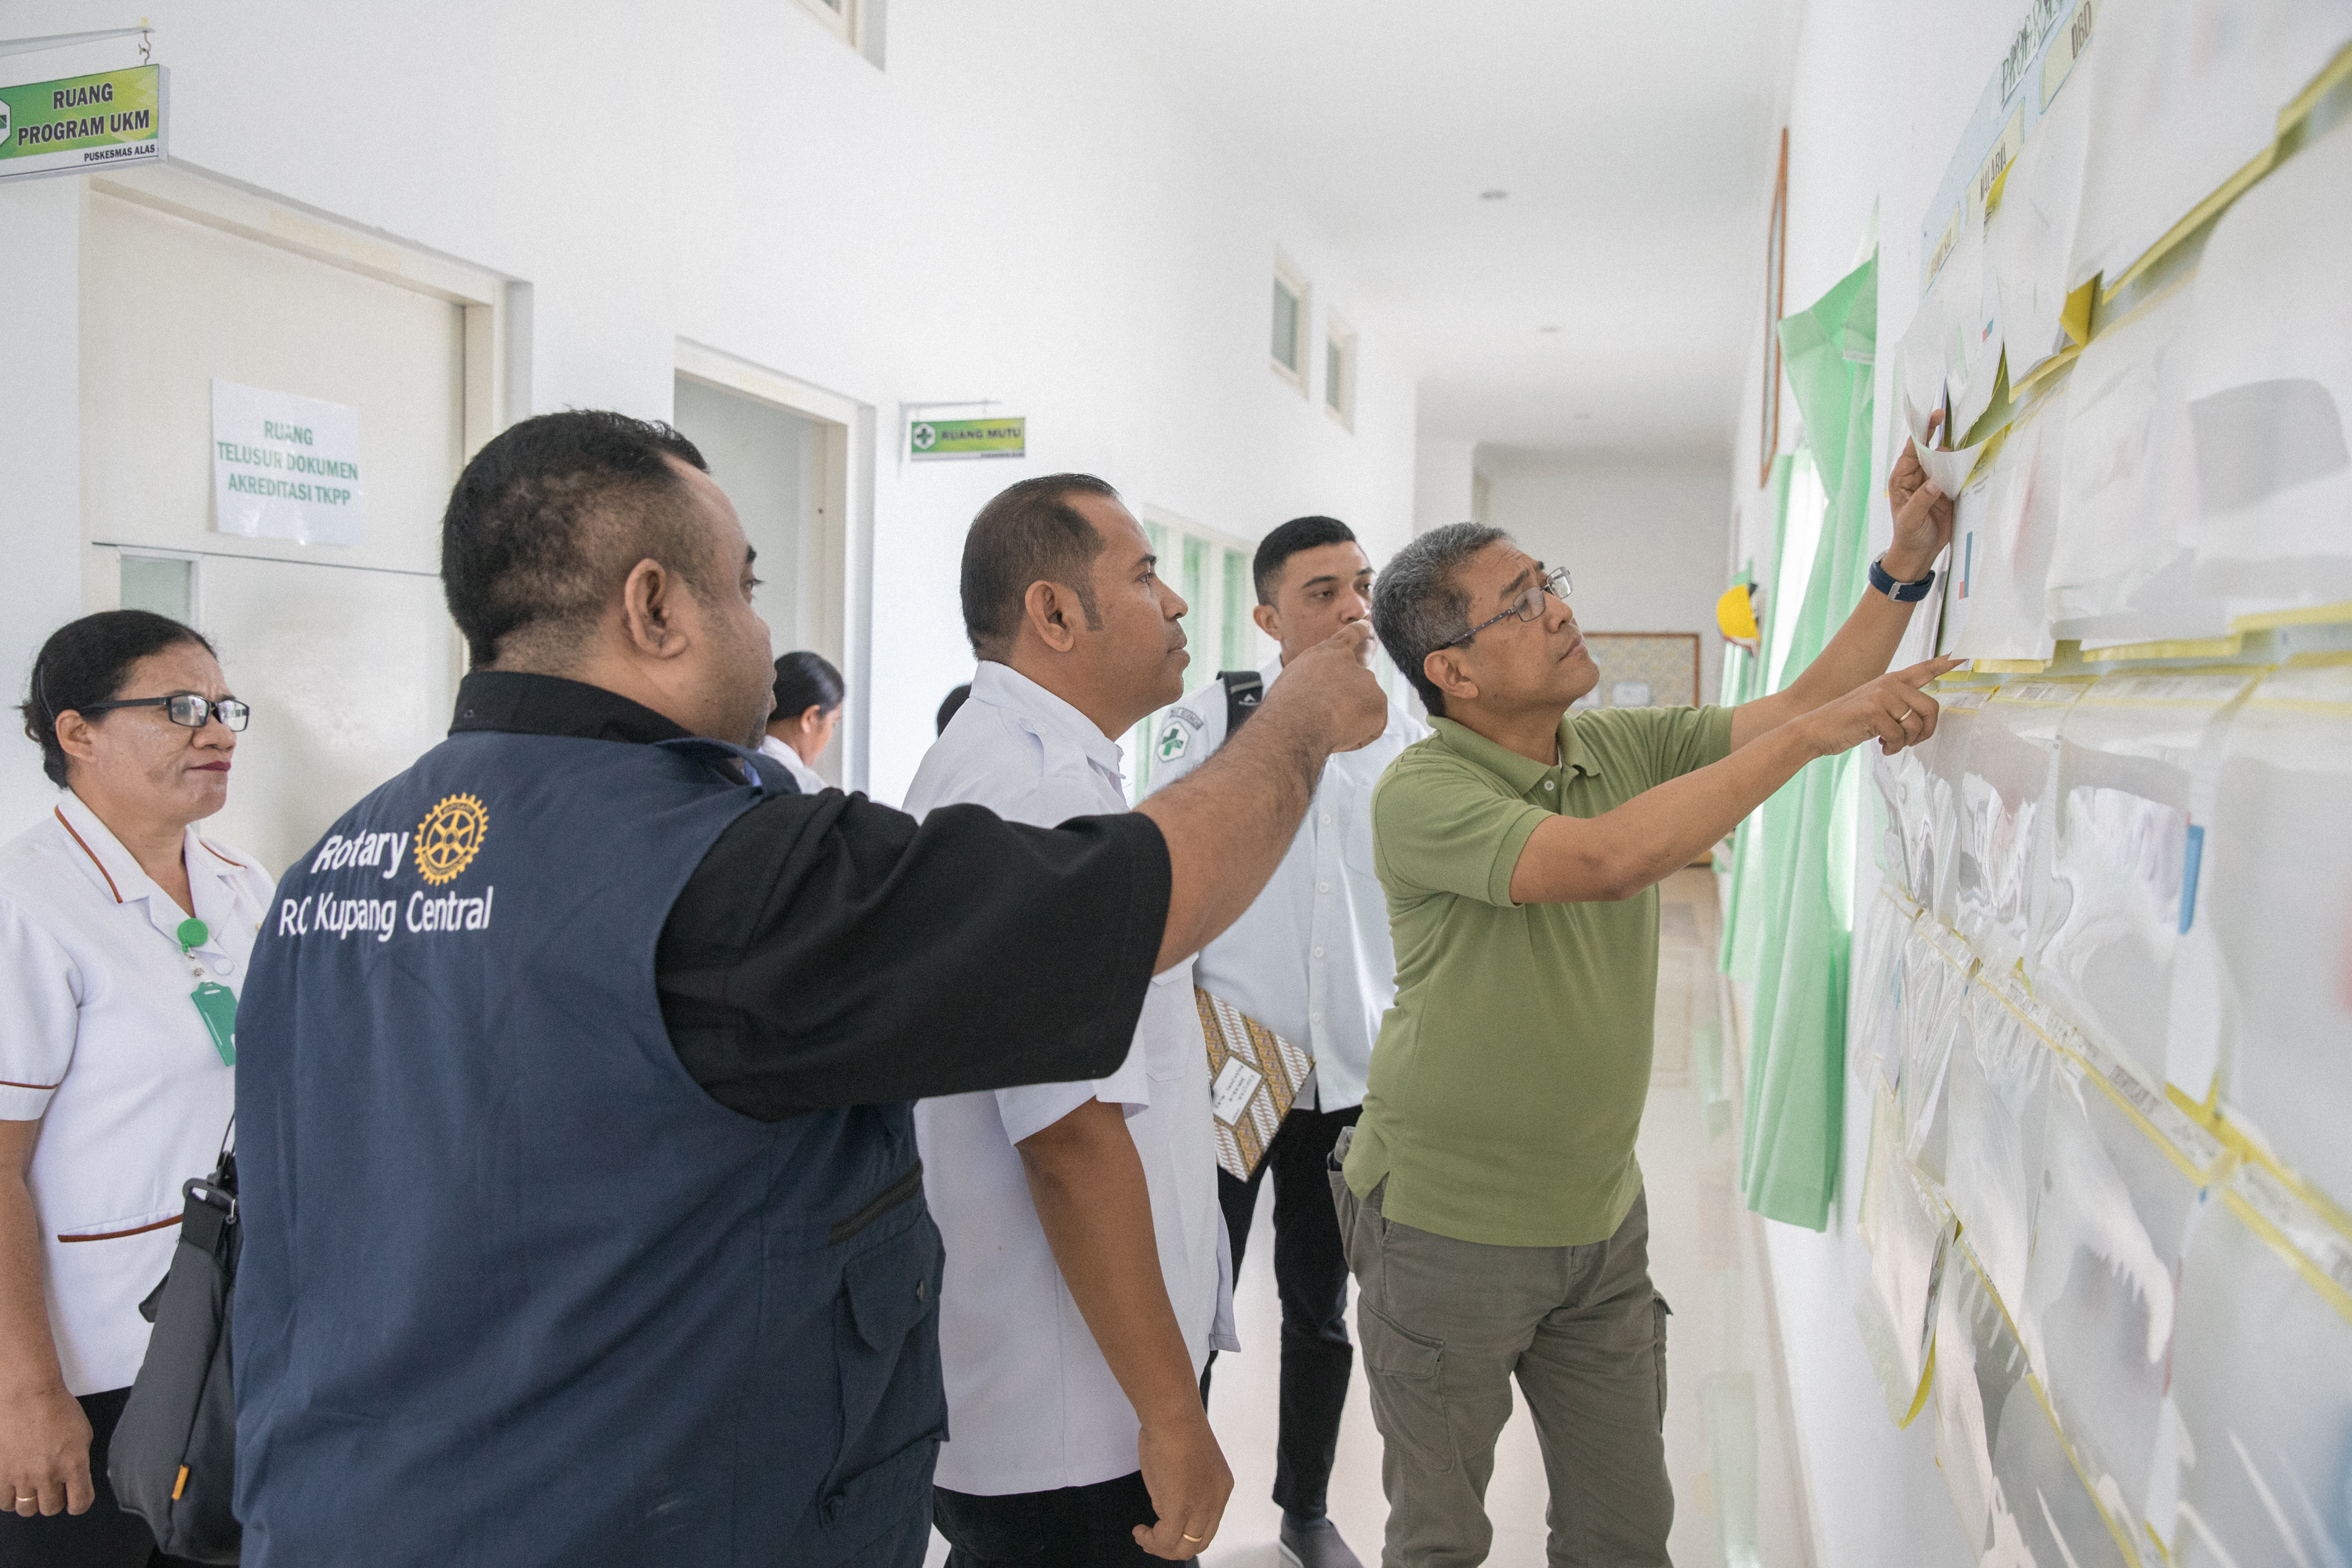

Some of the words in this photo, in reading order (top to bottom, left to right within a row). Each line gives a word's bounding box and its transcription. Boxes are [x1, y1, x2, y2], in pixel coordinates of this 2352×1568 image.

[2071, 1, 2092, 60] DBD
[53, 82, 114, 110] RUANG
[18, 115, 105, 146] PROGRAM
[110, 109, 150, 133] UKM
[84, 147, 132, 162] PUSKESMAS
[135, 144, 155, 155] ALAS
[263, 419, 314, 446] RUANG
[942, 430, 984, 441] RUANG
[987, 427, 1021, 439] MUTU
[217, 441, 282, 469] TELUSUR
[286, 452, 358, 481] DOKUMEN
[228, 473, 312, 502] AKREDITASI
[314, 485, 351, 506] TKPP
[310, 829, 409, 880] Rotary
[278, 895, 312, 937] RC
[313, 891, 397, 942] Kupang
[405, 885, 494, 933] Central
